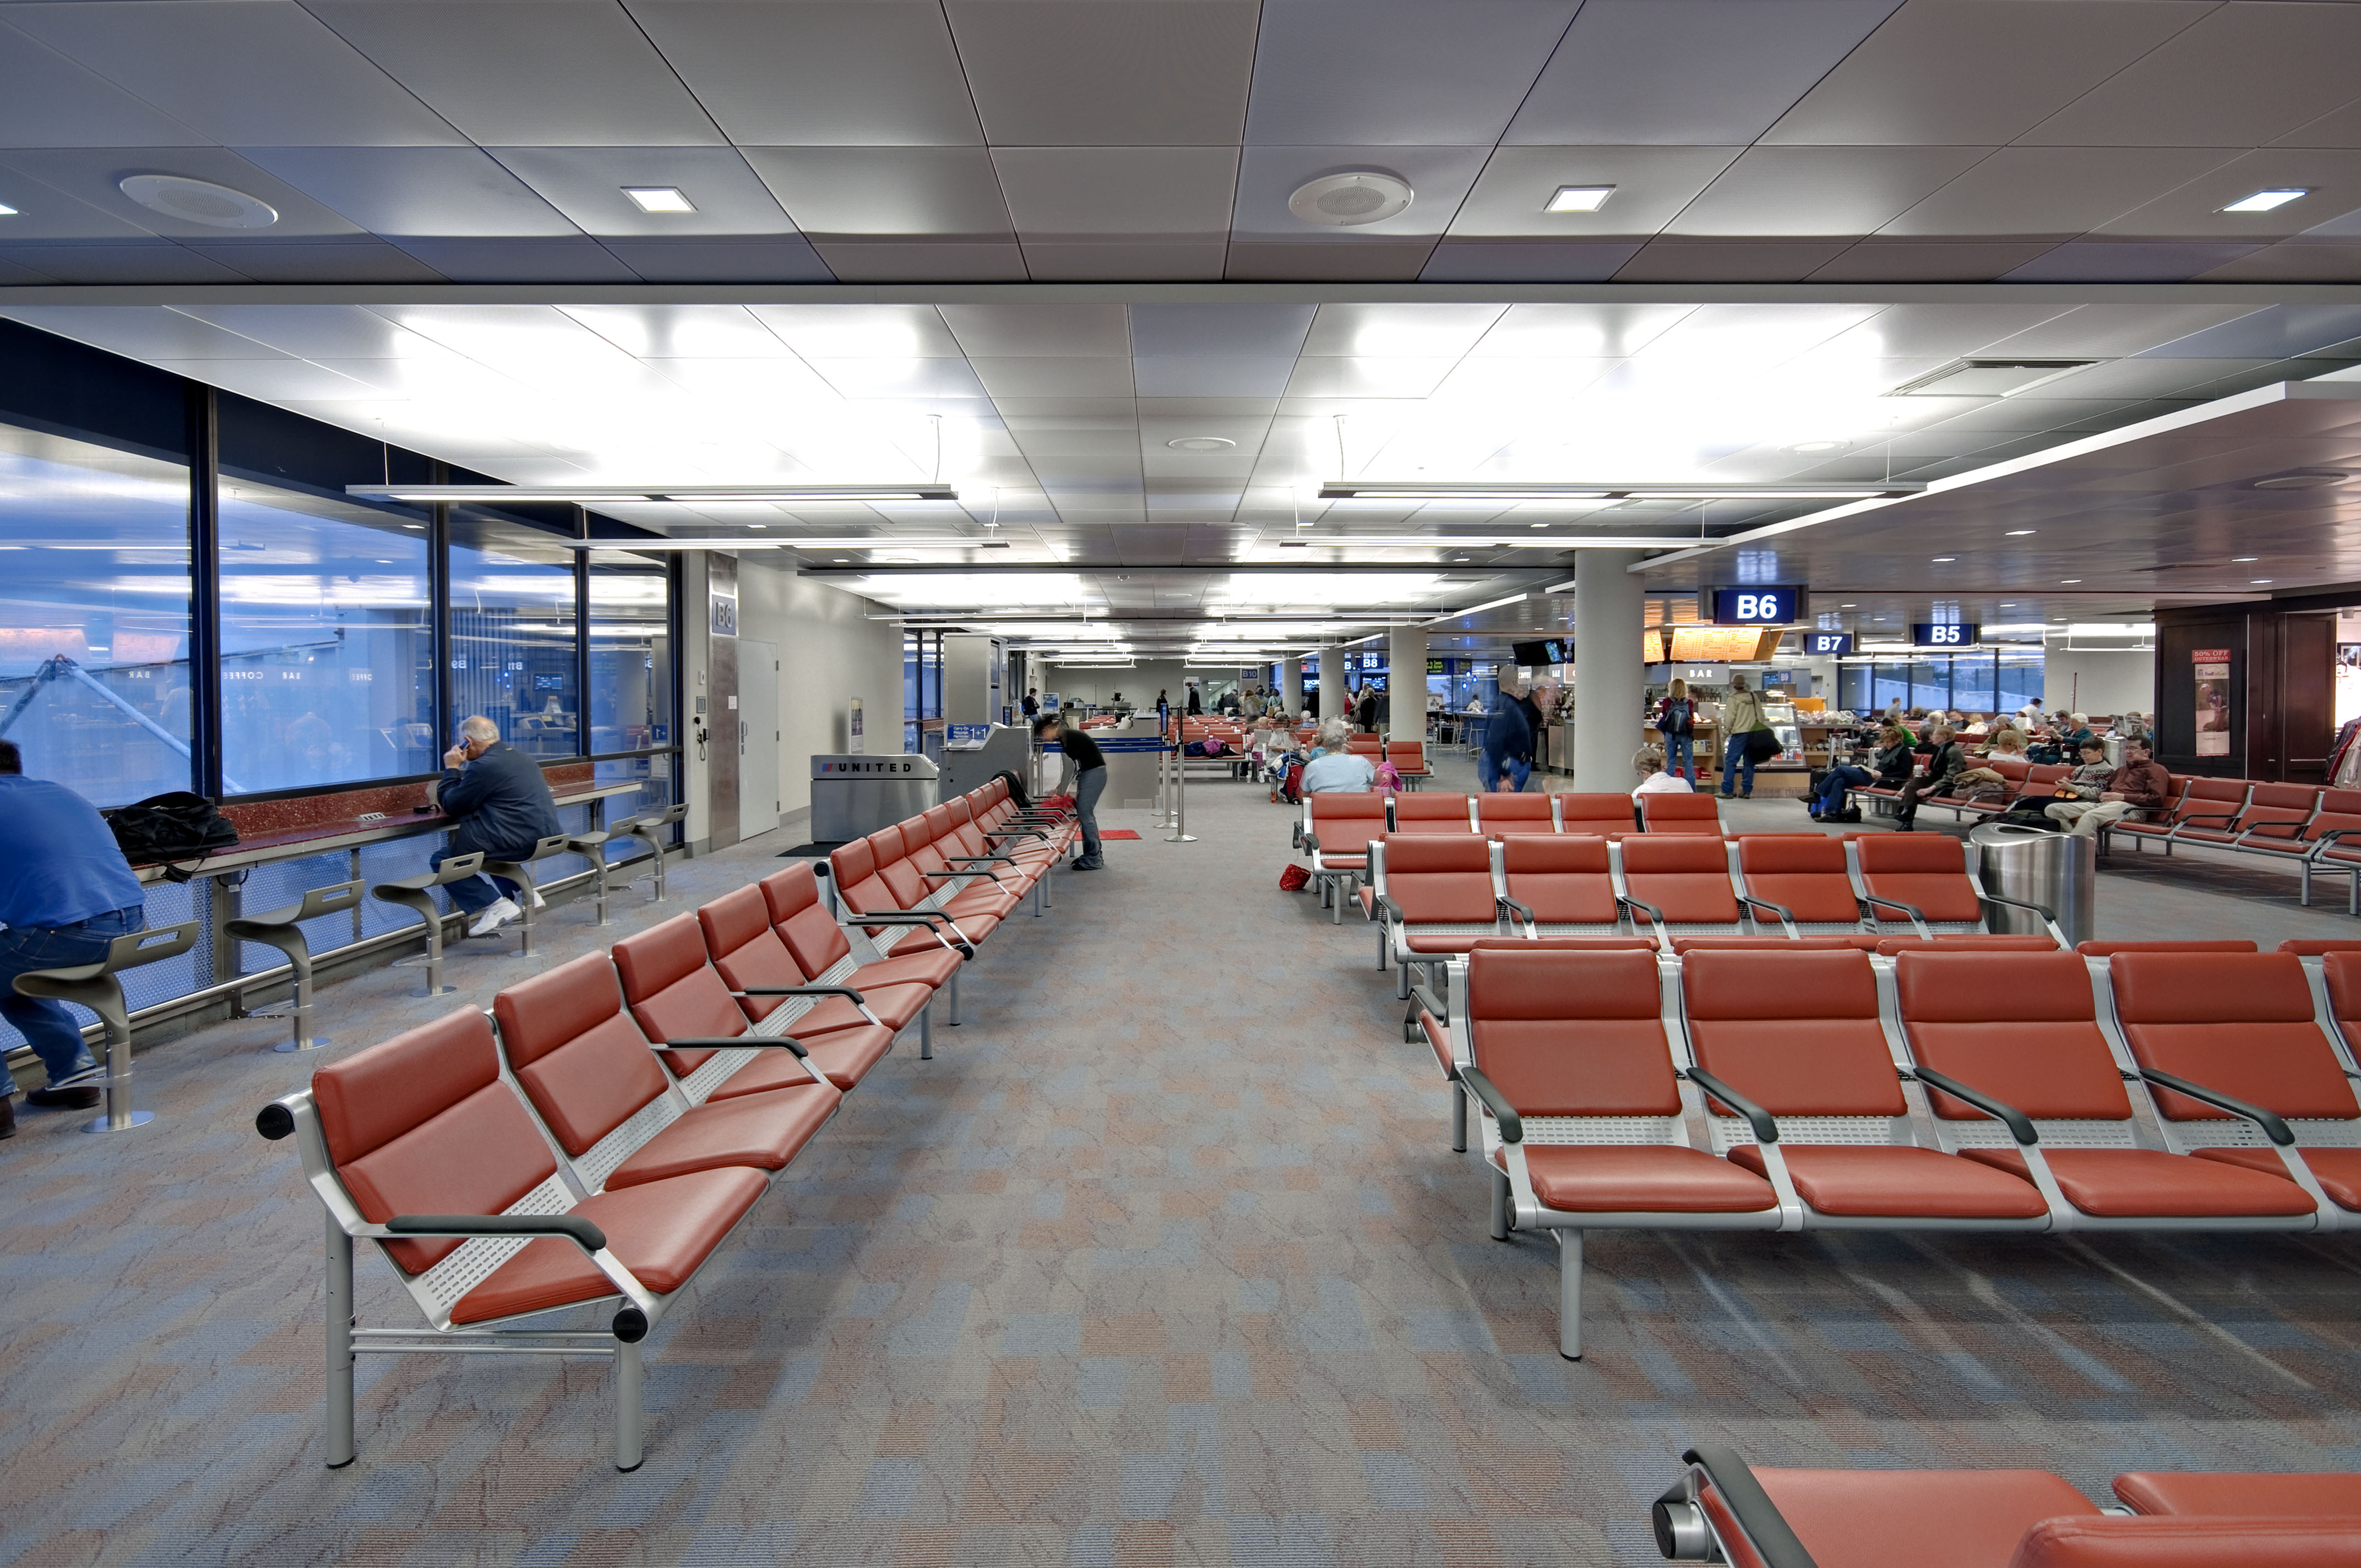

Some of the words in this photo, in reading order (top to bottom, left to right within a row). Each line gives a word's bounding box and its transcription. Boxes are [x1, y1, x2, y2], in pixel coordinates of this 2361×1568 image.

[1737, 595, 1777, 619] B6
[716, 602, 732, 628] B6
[1931, 625, 1960, 643] B5
[1817, 636, 1843, 651] B7
[1363, 658, 1378, 668] B8
[1552, 669, 1560, 678] BAR
[1689, 669, 1712, 678] BAR
[1781, 673, 1788, 681] B9
[970, 727, 986, 738] 1+1
[839, 763, 911, 772] UNITED
